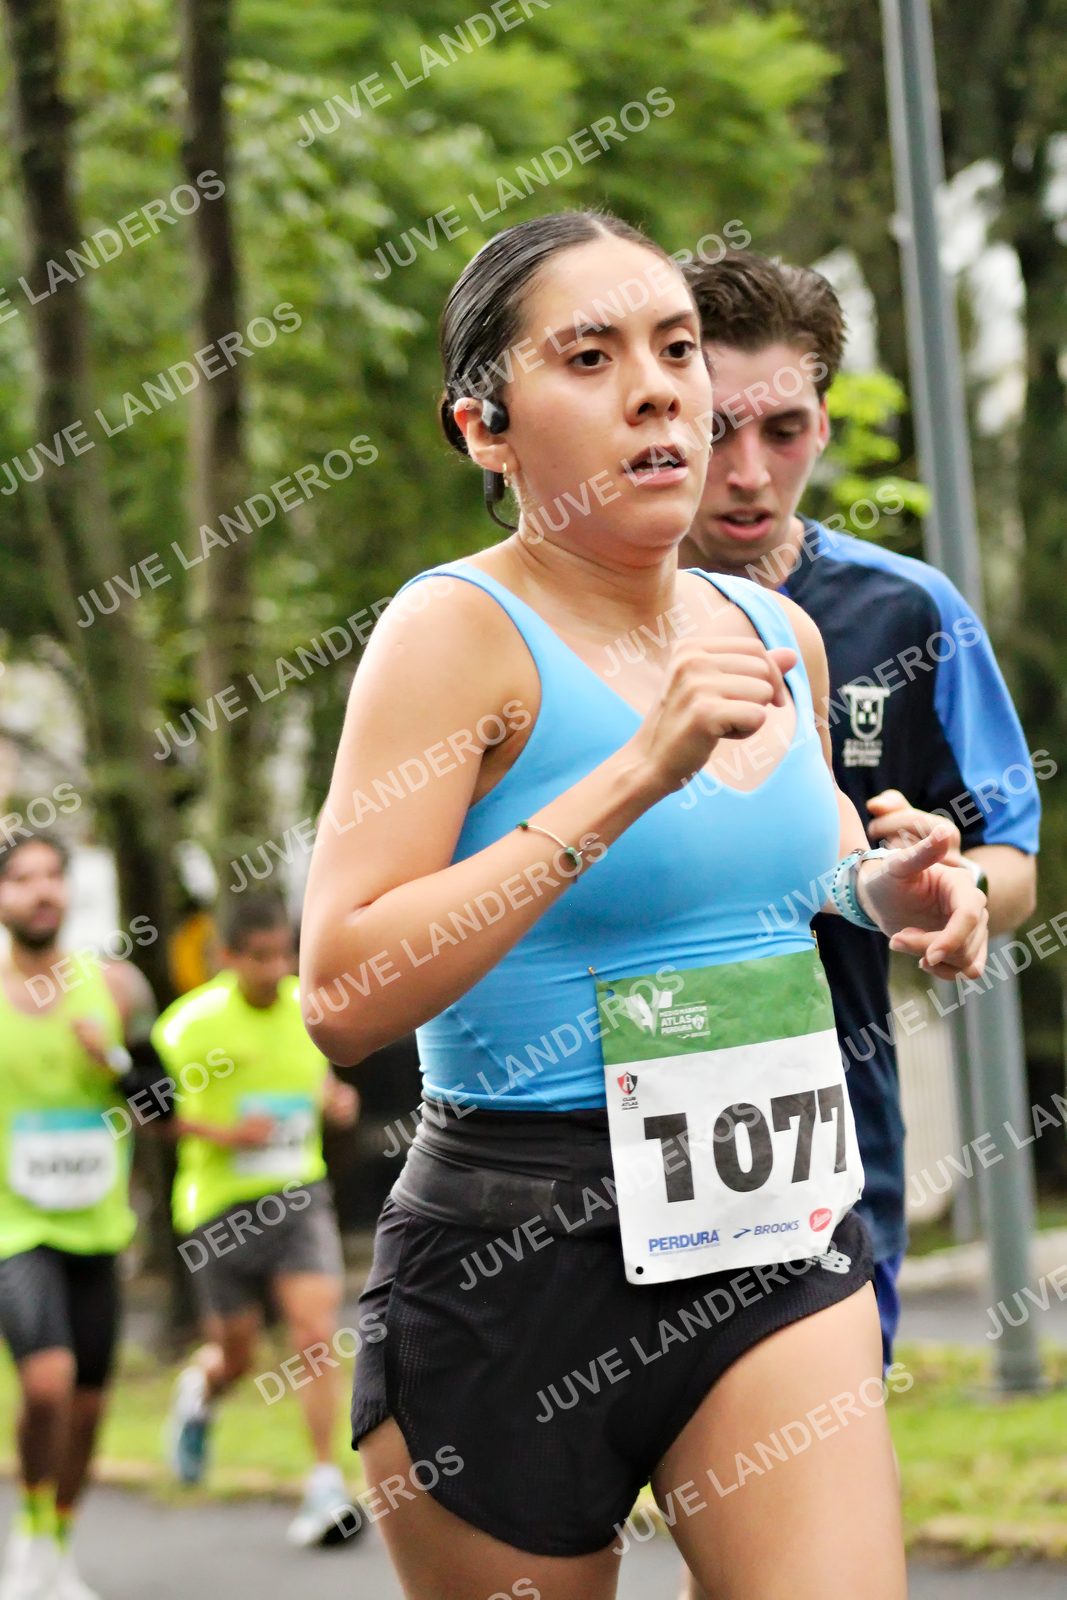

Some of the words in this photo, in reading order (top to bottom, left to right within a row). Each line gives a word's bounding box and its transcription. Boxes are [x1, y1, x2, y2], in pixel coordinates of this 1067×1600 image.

[661, 1014, 692, 1027] ATLAS
[644, 1083, 847, 1203] 1077
[753, 1219, 800, 1236] BROOKS
[649, 1229, 720, 1252] PERDURA
